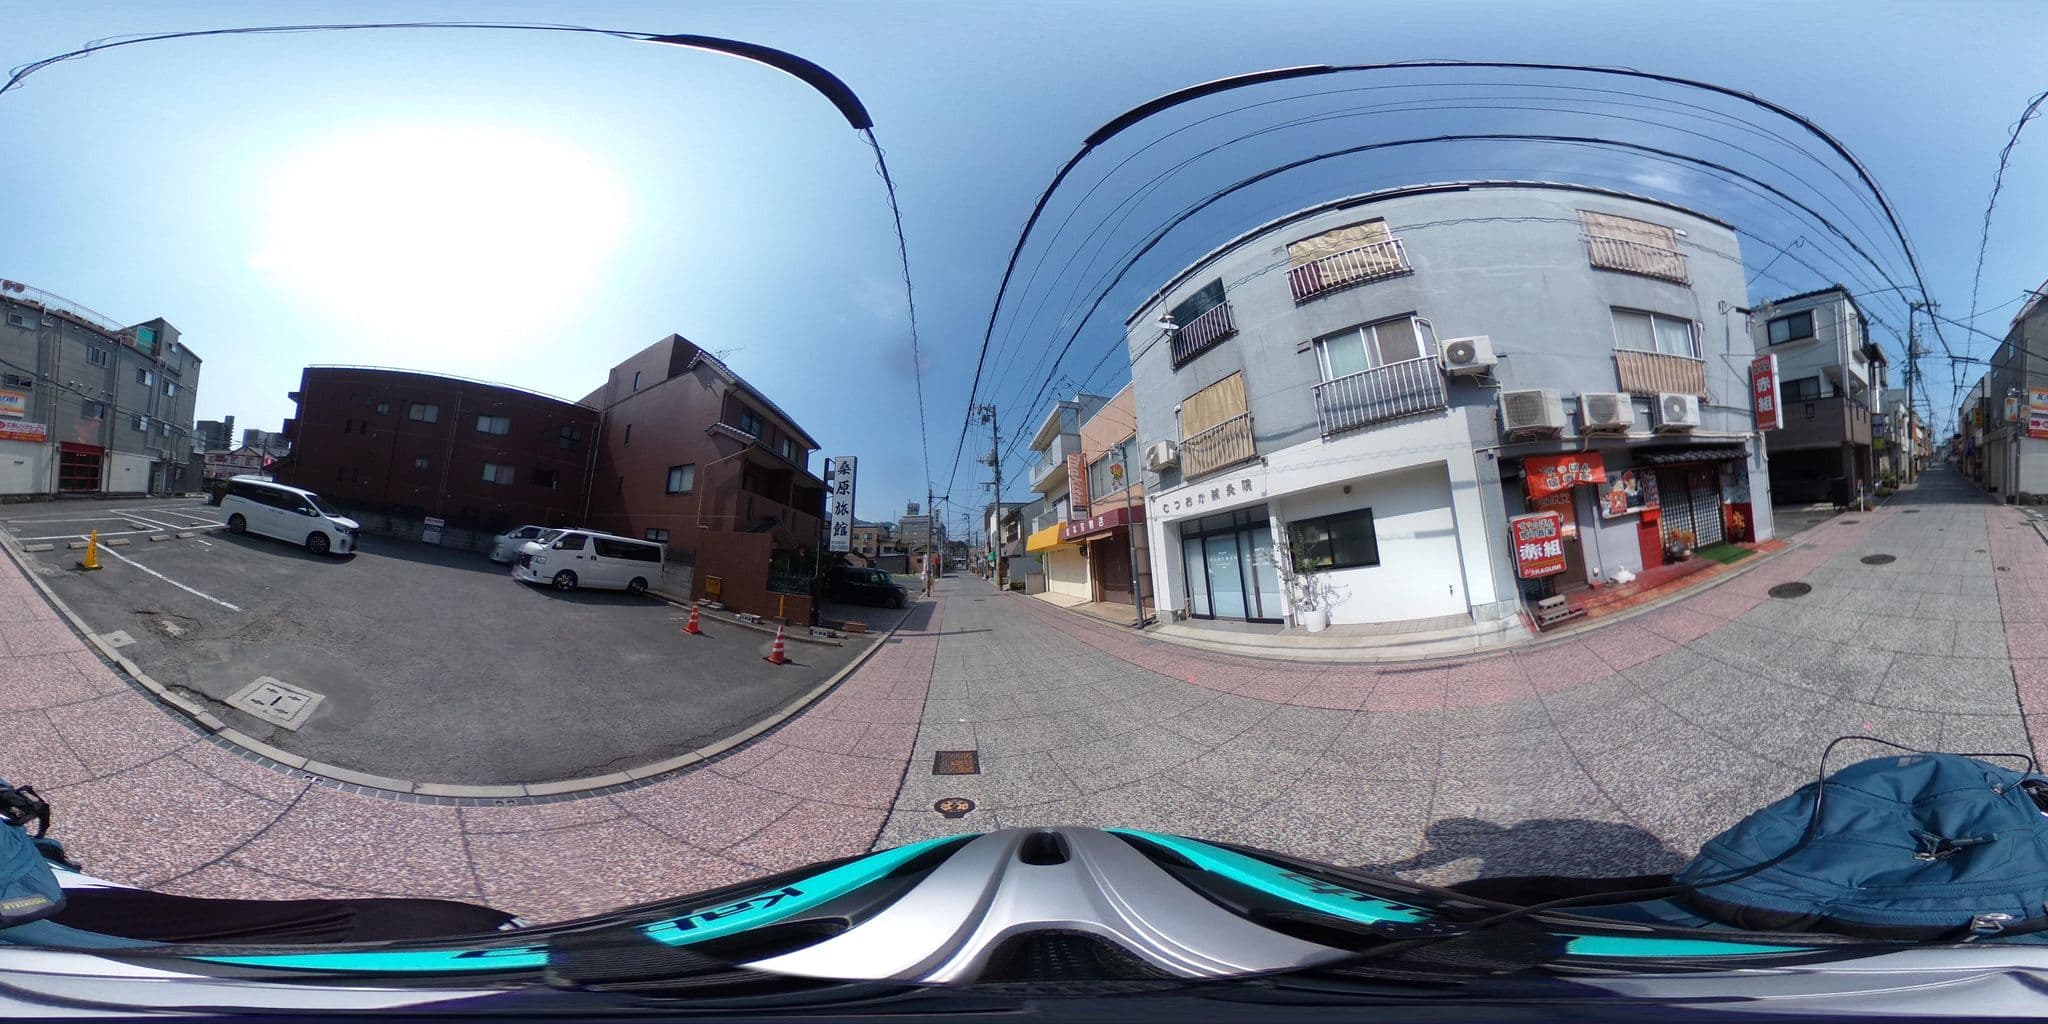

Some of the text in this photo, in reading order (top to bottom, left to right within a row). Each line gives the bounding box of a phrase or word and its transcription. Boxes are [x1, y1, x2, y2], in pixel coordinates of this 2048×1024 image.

[1756, 376, 1773, 414] 赤組
[833, 460, 852, 537] 桑原旅館
[1519, 539, 1562, 561] 赤組
